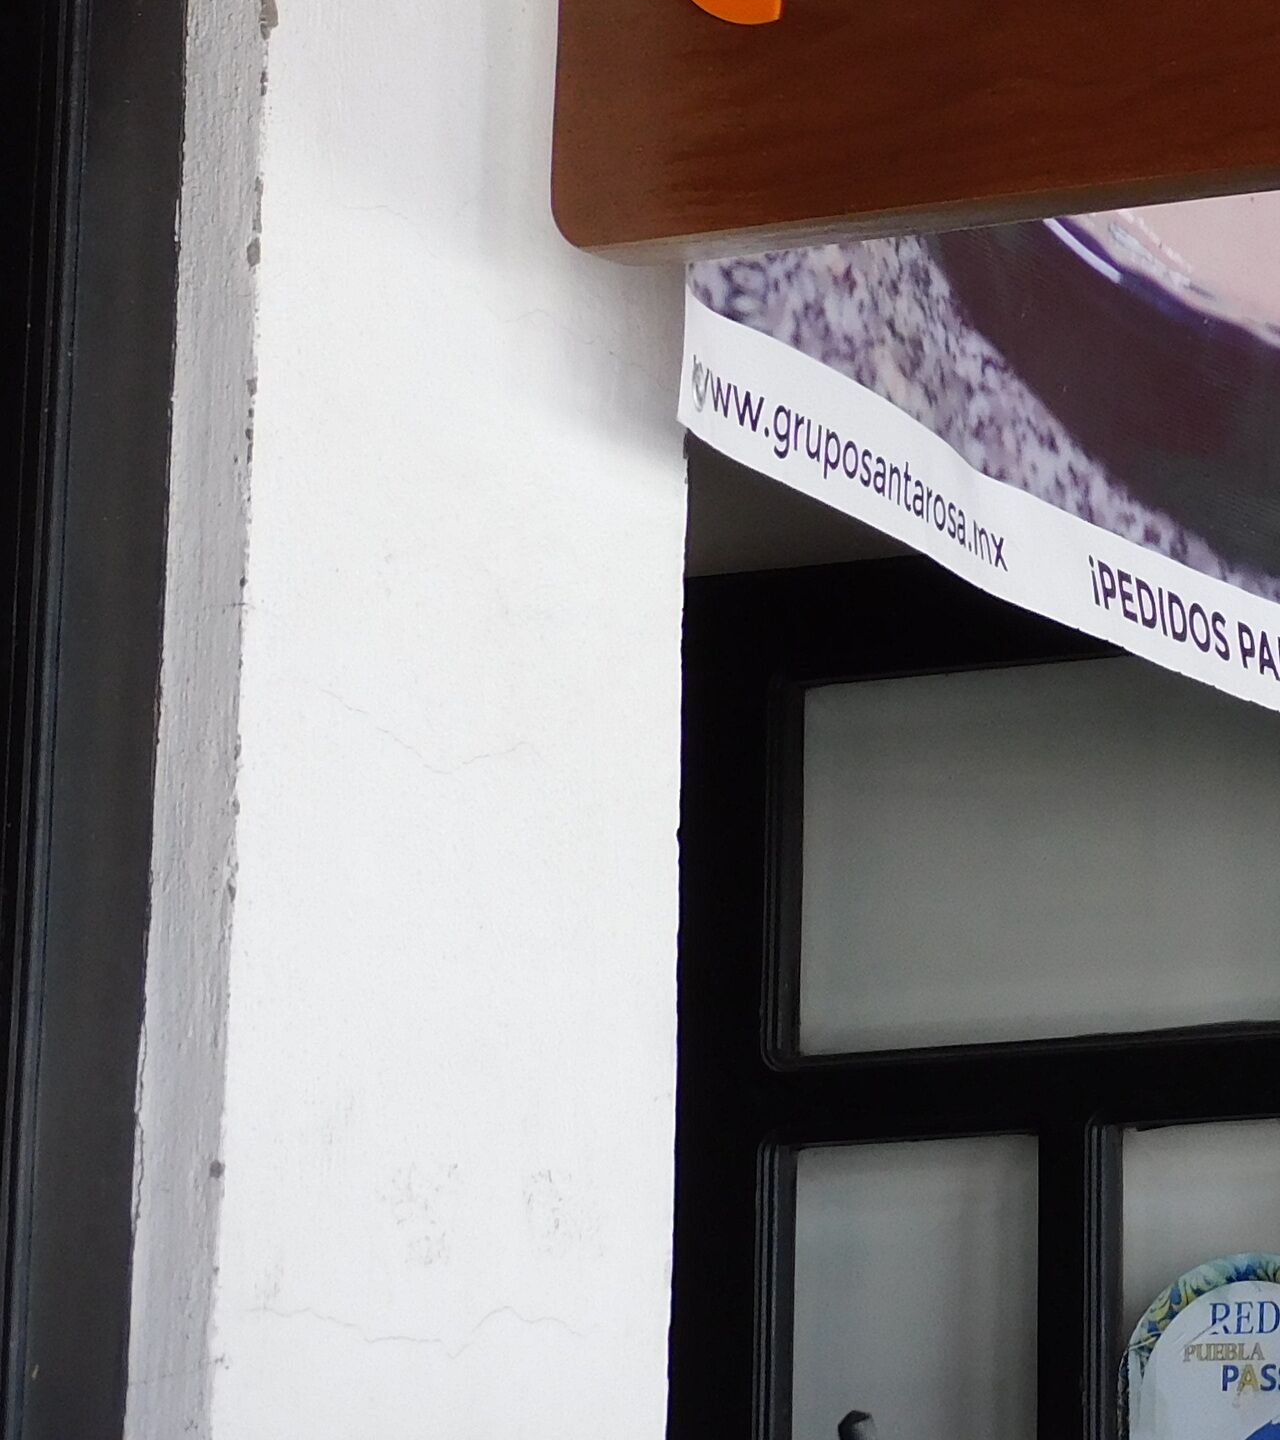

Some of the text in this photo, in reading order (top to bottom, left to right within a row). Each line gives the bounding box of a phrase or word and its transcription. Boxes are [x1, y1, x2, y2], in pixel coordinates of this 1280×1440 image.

[1089, 555, 1231, 661] ¡PEDIDOS
[1209, 1301, 1280, 1335] RED
[1183, 1341, 1266, 1362] PUEBLA
